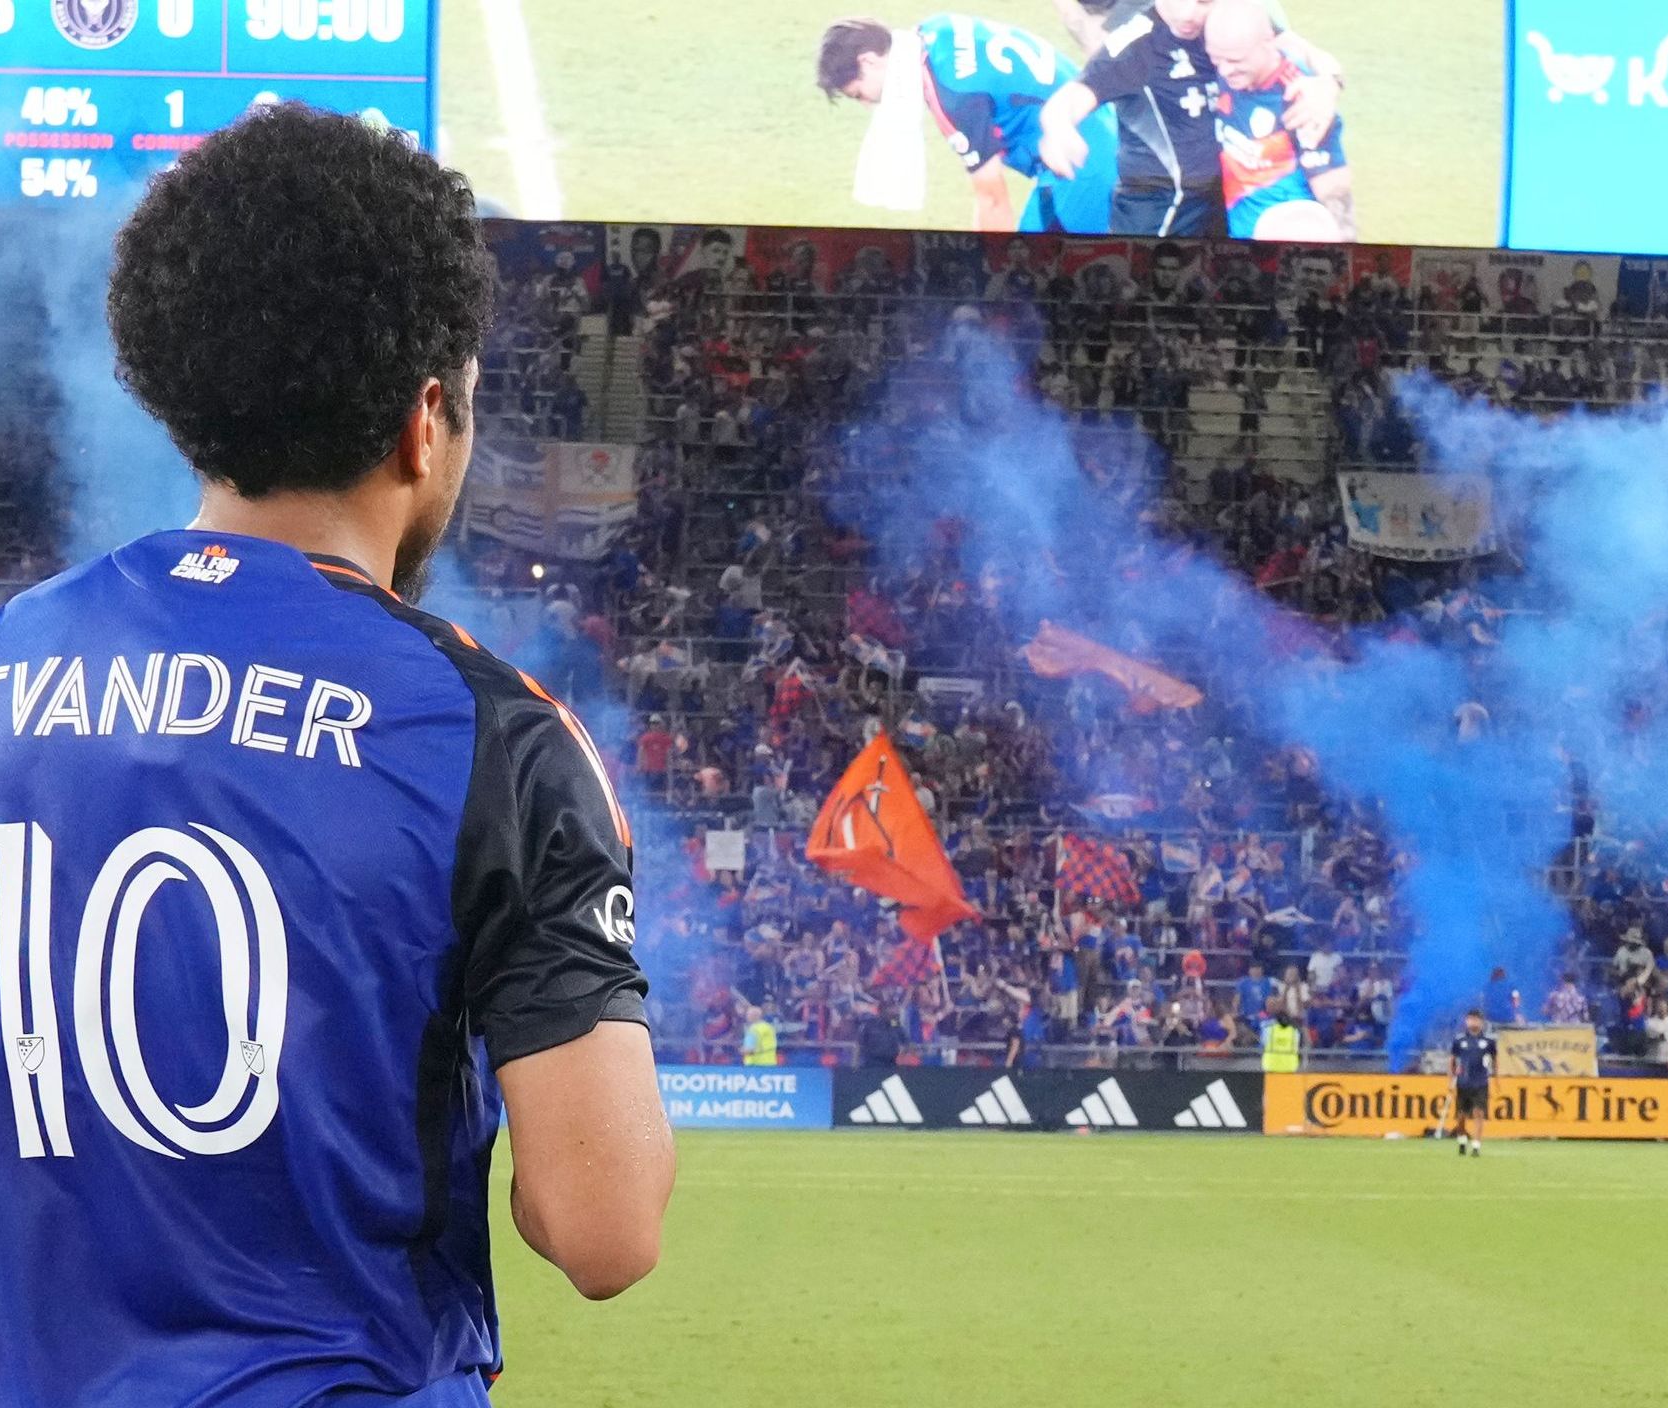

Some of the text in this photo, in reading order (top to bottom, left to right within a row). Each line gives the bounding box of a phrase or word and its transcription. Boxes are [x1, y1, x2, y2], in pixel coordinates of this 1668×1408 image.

[165, 90, 184, 128] 1
[20, 157, 98, 198] 54%
[179, 553, 241, 573] ALL FOR
[170, 565, 234, 584] CINCY
[659, 1073, 797, 1094] TOOTHPASTE
[670, 1100, 796, 1120] IN AMERICA
[1305, 1082, 1660, 1128] Contineal Tire
